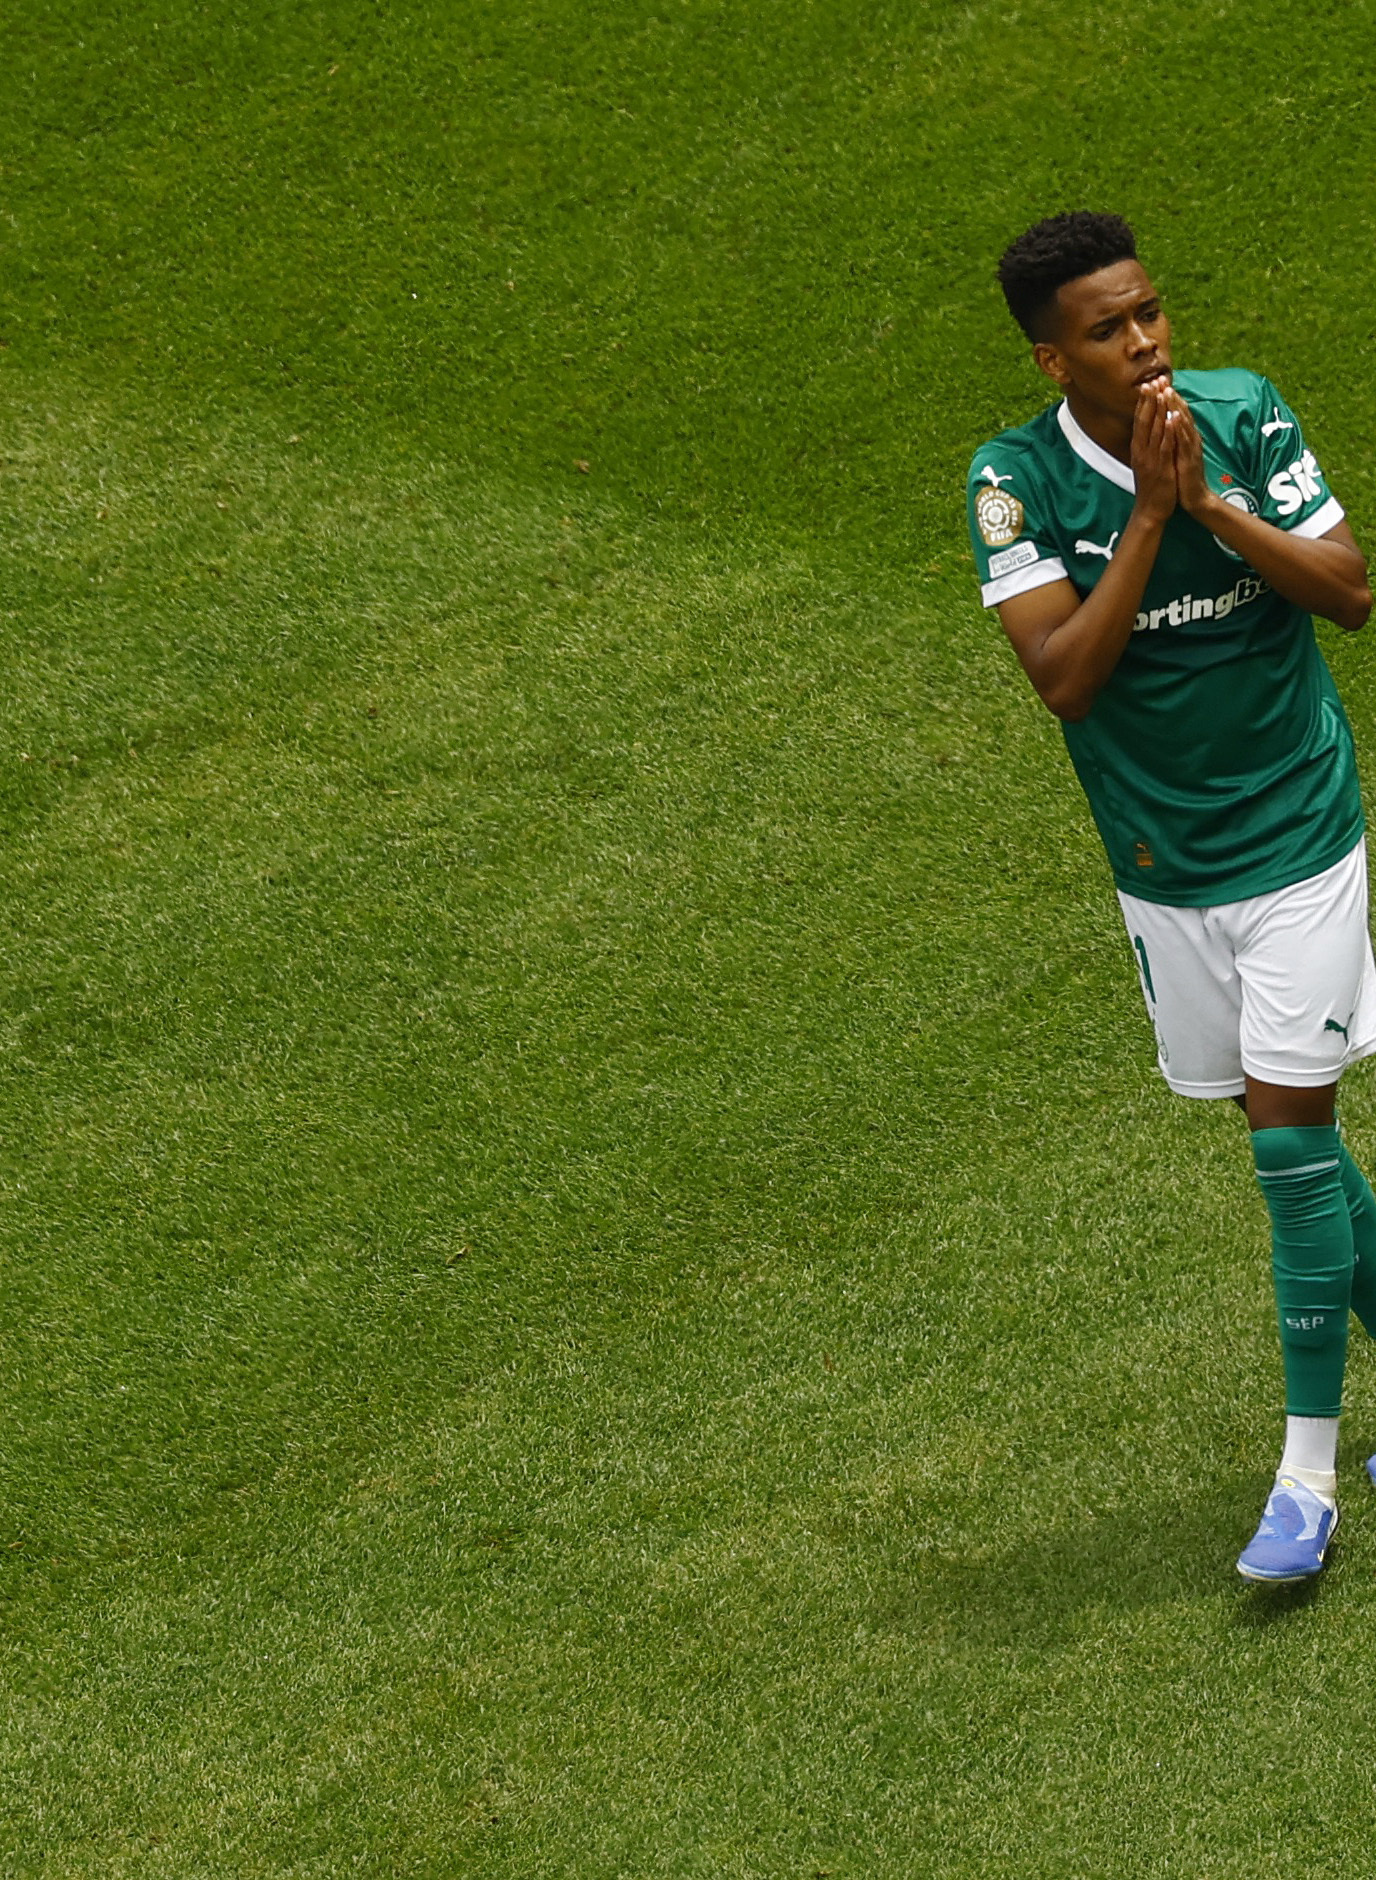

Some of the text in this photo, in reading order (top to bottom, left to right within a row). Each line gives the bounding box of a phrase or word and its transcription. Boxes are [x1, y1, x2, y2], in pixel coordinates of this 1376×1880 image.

[990, 528, 1014, 543] FIFA
[1132, 577, 1272, 631] ortingbe
[1285, 1316, 1325, 1330] SEP
